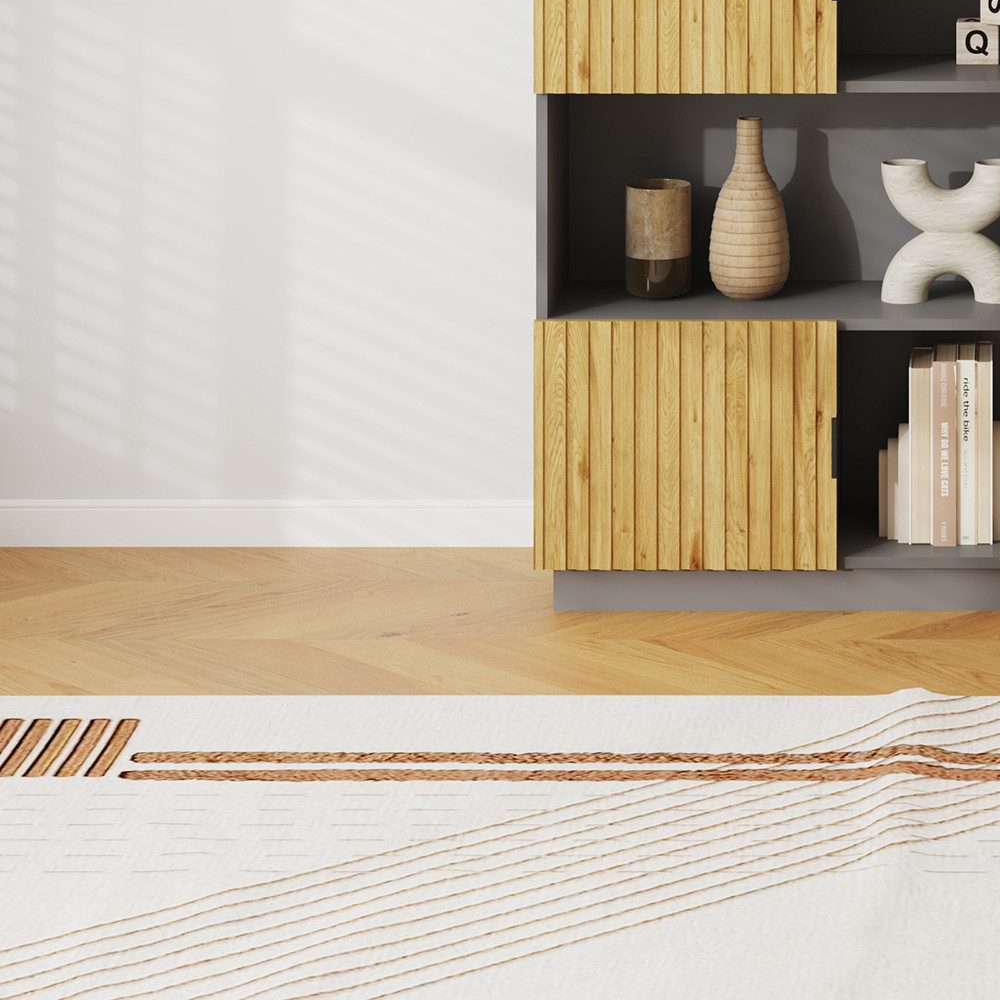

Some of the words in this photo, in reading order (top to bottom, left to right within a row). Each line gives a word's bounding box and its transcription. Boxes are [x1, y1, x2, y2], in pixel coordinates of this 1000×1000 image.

[965, 29, 988, 56] Q
[940, 422, 949, 437] WHY
[940, 438, 949, 449] DO
[940, 450, 949, 461] WE
[940, 462, 949, 479] LOVE
[940, 480, 949, 497] CATS
